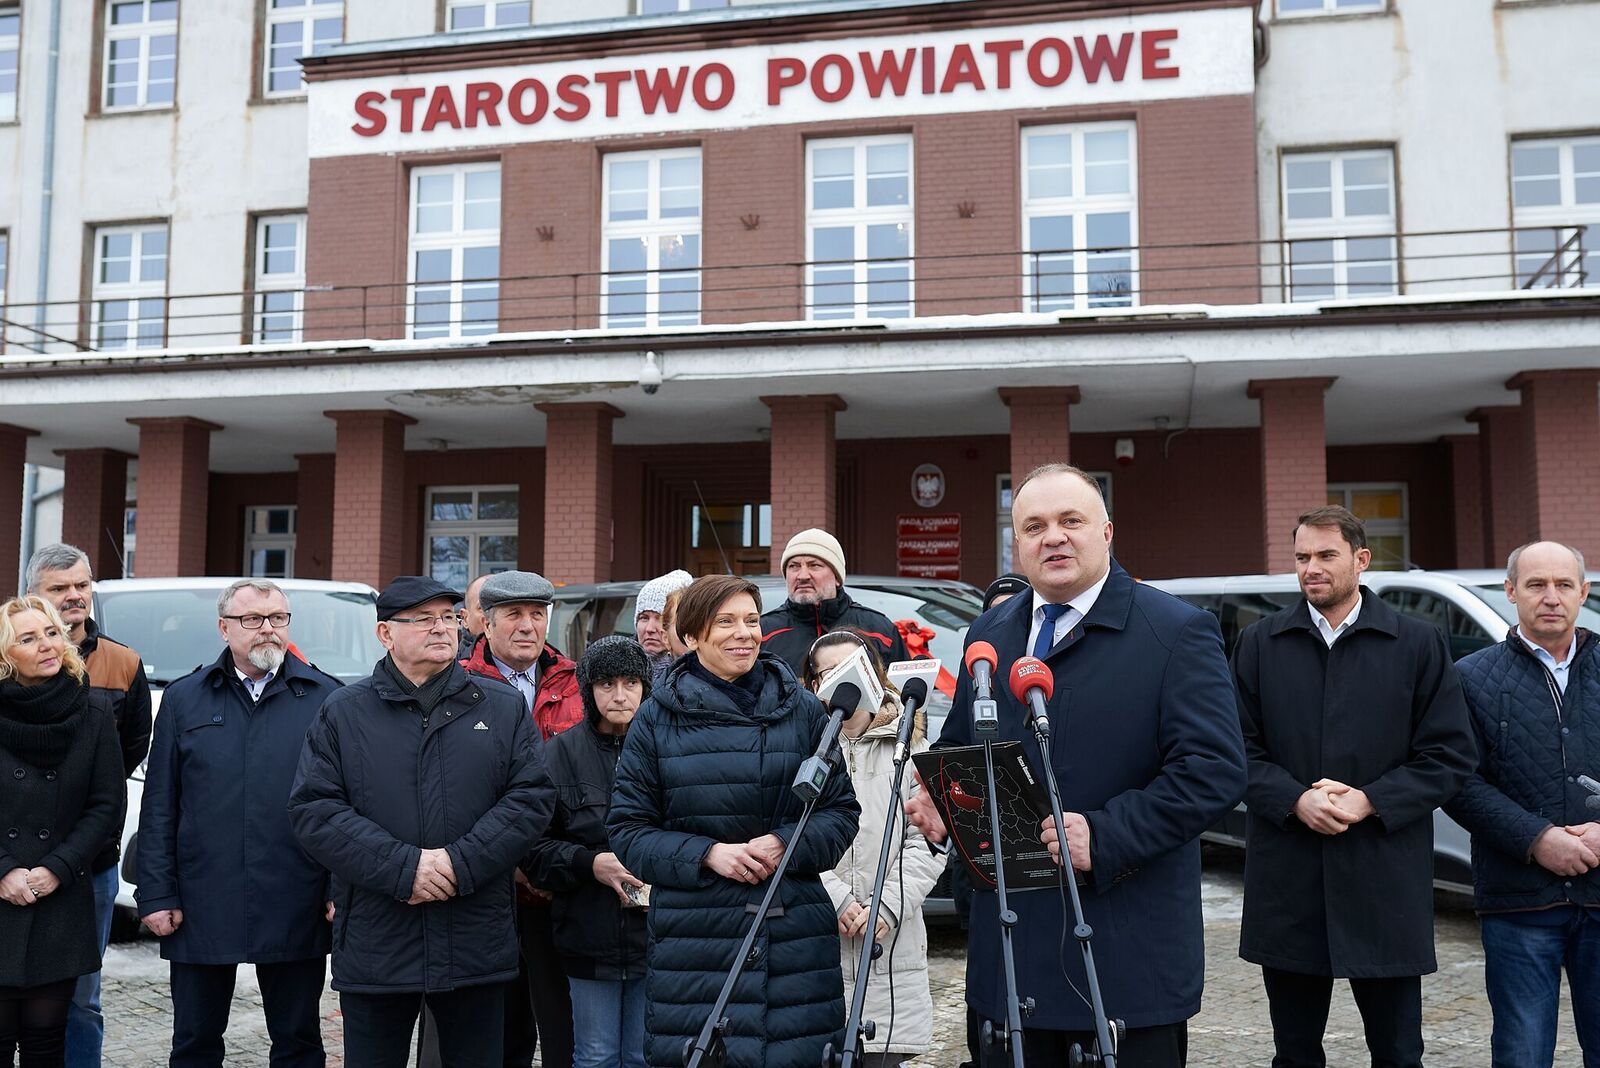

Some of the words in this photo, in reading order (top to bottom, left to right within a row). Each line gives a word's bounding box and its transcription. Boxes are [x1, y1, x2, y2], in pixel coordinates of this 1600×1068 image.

[351, 62, 735, 137] STAROSTWO
[767, 29, 1180, 106] POWIATOWE
[899, 518, 921, 526] RADA
[922, 518, 959, 526] POWIATU
[927, 540, 959, 549] POWIATU
